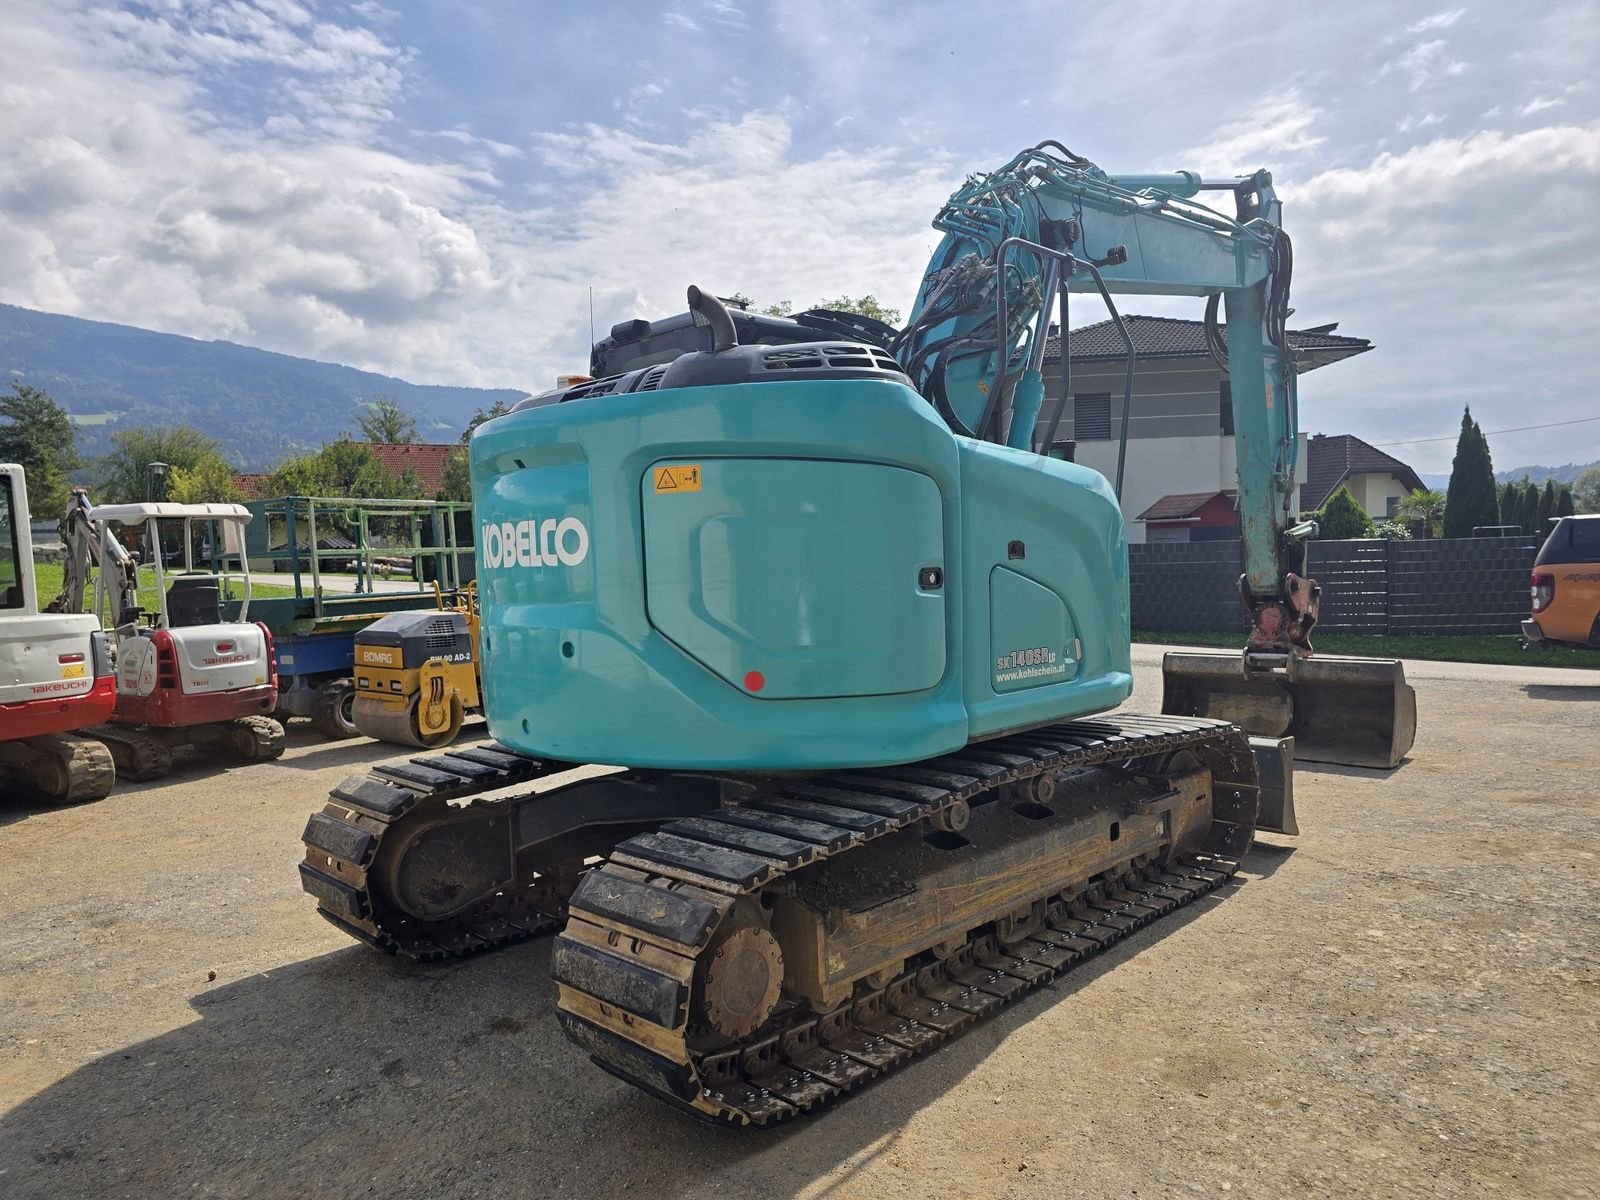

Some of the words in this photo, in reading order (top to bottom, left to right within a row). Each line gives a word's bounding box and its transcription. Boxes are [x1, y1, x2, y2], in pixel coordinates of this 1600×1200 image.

[482, 517, 589, 568] KOBELCO
[363, 651, 392, 664] BOMAG
[454, 652, 471, 661] AD-2
[997, 663, 1066, 682] www.kohlschein.at
[30, 680, 87, 694] TAKEUCHI
